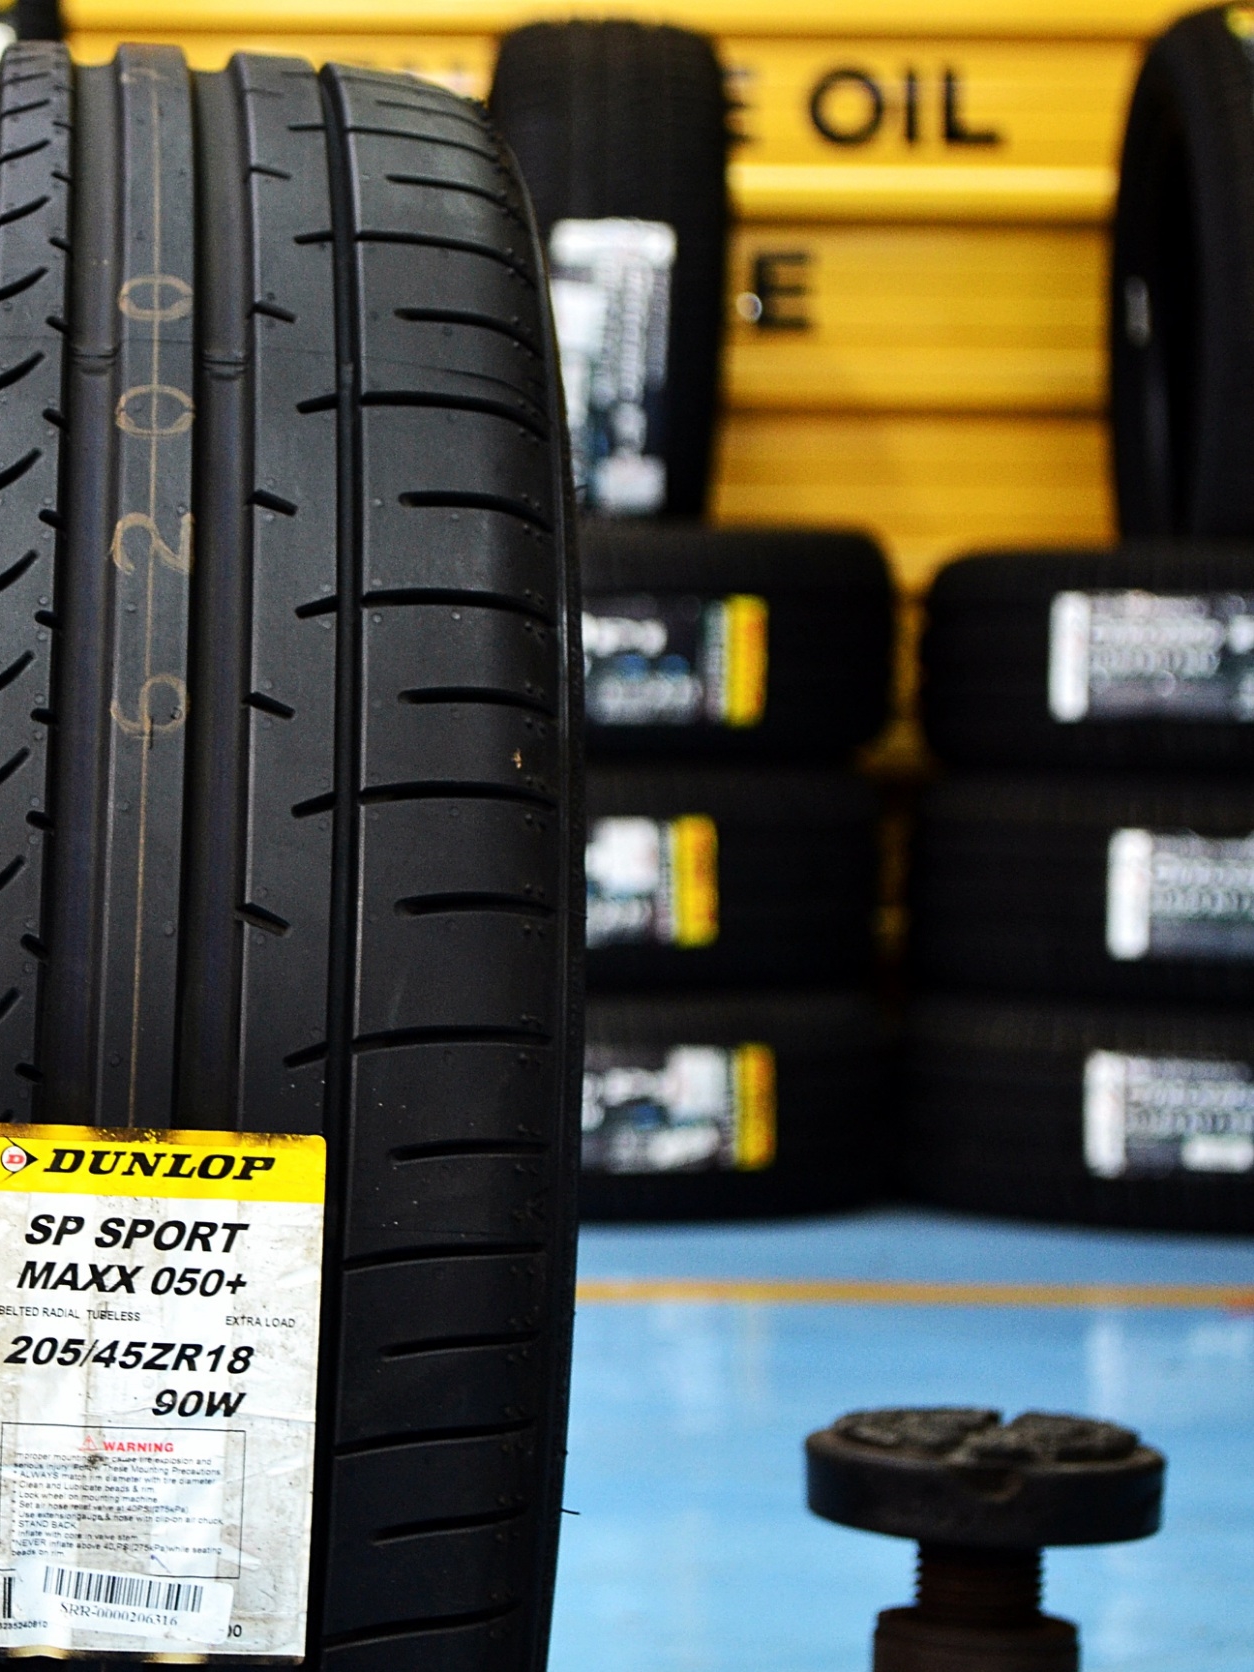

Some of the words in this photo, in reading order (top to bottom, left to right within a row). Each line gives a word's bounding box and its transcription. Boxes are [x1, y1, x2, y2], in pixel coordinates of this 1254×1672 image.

[808, 66, 1000, 146] OIL
[43, 1148, 276, 1181] DUNLOP
[25, 1214, 85, 1246] SP
[95, 1217, 249, 1253] SPORT
[16, 1261, 145, 1294] MAXX
[150, 1266, 247, 1297] 050+
[42, 1307, 80, 1319] RADIAL
[87, 1309, 141, 1322] TUBELESS
[225, 1315, 262, 1327] EXTRA
[265, 1317, 296, 1328] LOAD
[3, 1335, 255, 1375] 205/45ZR18
[151, 1388, 247, 1418] 90W
[102, 1441, 174, 1453] WARNING
[20, 1470, 59, 1480] ALWAYS
[18, 1480, 44, 1490] Clean
[46, 1481, 62, 1490] and
[18, 1491, 39, 1499] Lock
[42, 1492, 67, 1500] wheel
[68, 1493, 79, 1501] on
[81, 1493, 120, 1504] mounting
[19, 1500, 33, 1509] Set
[48, 1501, 68, 1510] hose
[116, 1504, 124, 1512] at
[18, 1510, 35, 1519] Use
[136, 1515, 153, 1523] with
[18, 1519, 49, 1529] STAND
[45, 1530, 62, 1539] with
[76, 1540, 101, 1550] above
